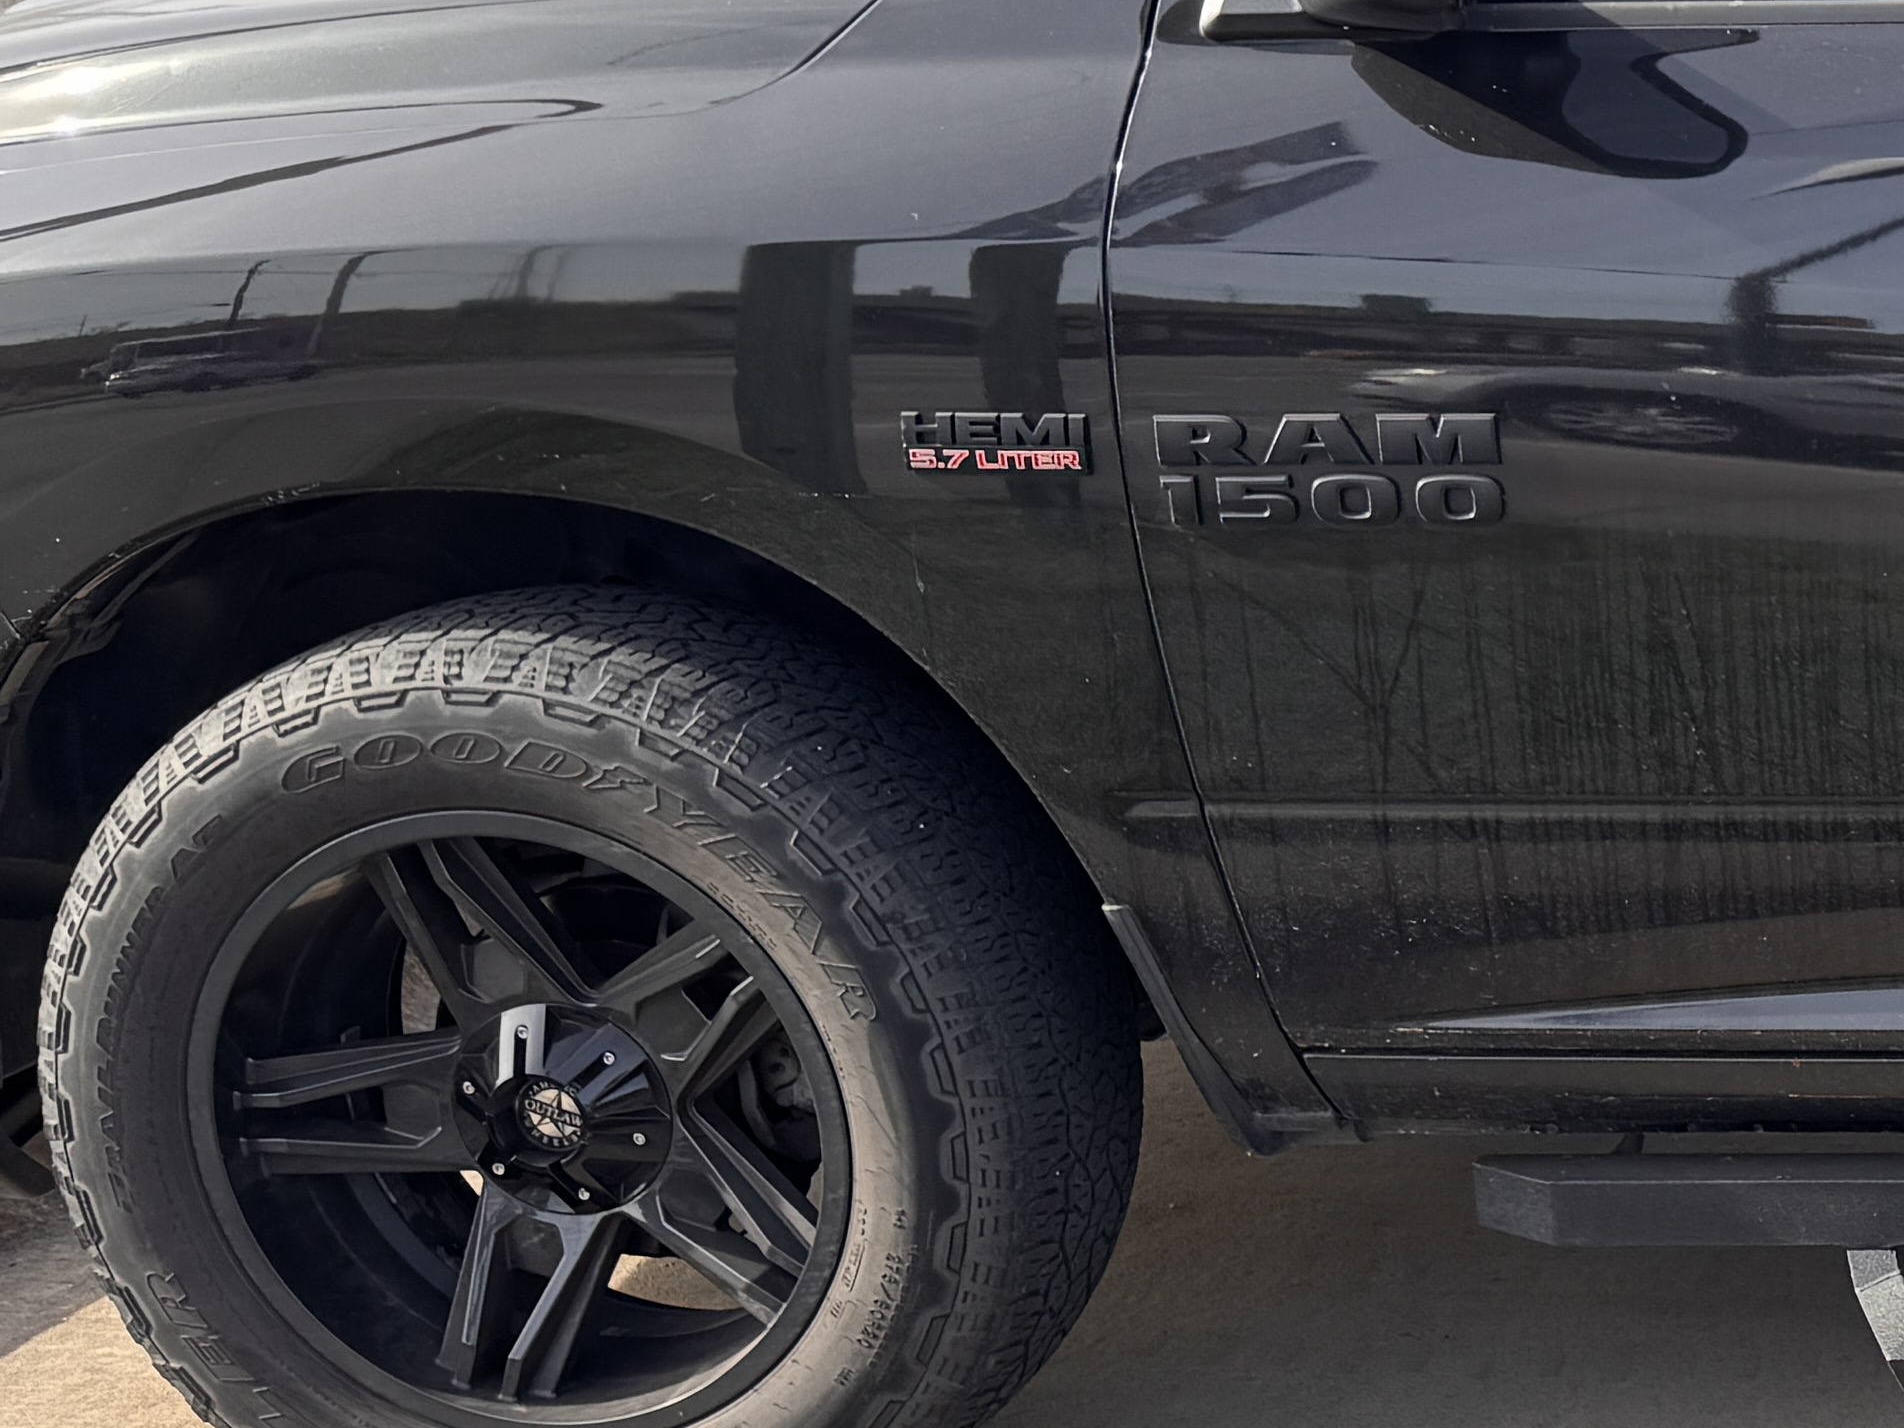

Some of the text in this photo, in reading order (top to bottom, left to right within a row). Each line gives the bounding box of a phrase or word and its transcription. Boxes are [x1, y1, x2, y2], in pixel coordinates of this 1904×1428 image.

[901, 411, 1089, 447] HEMI
[1152, 413, 1502, 467] RAM
[909, 448, 1083, 471] 5.7 LITER
[1158, 474, 1507, 528] 1500
[281, 731, 878, 1021] GOODYEAR
[524, 1098, 584, 1127] OUTLAW
